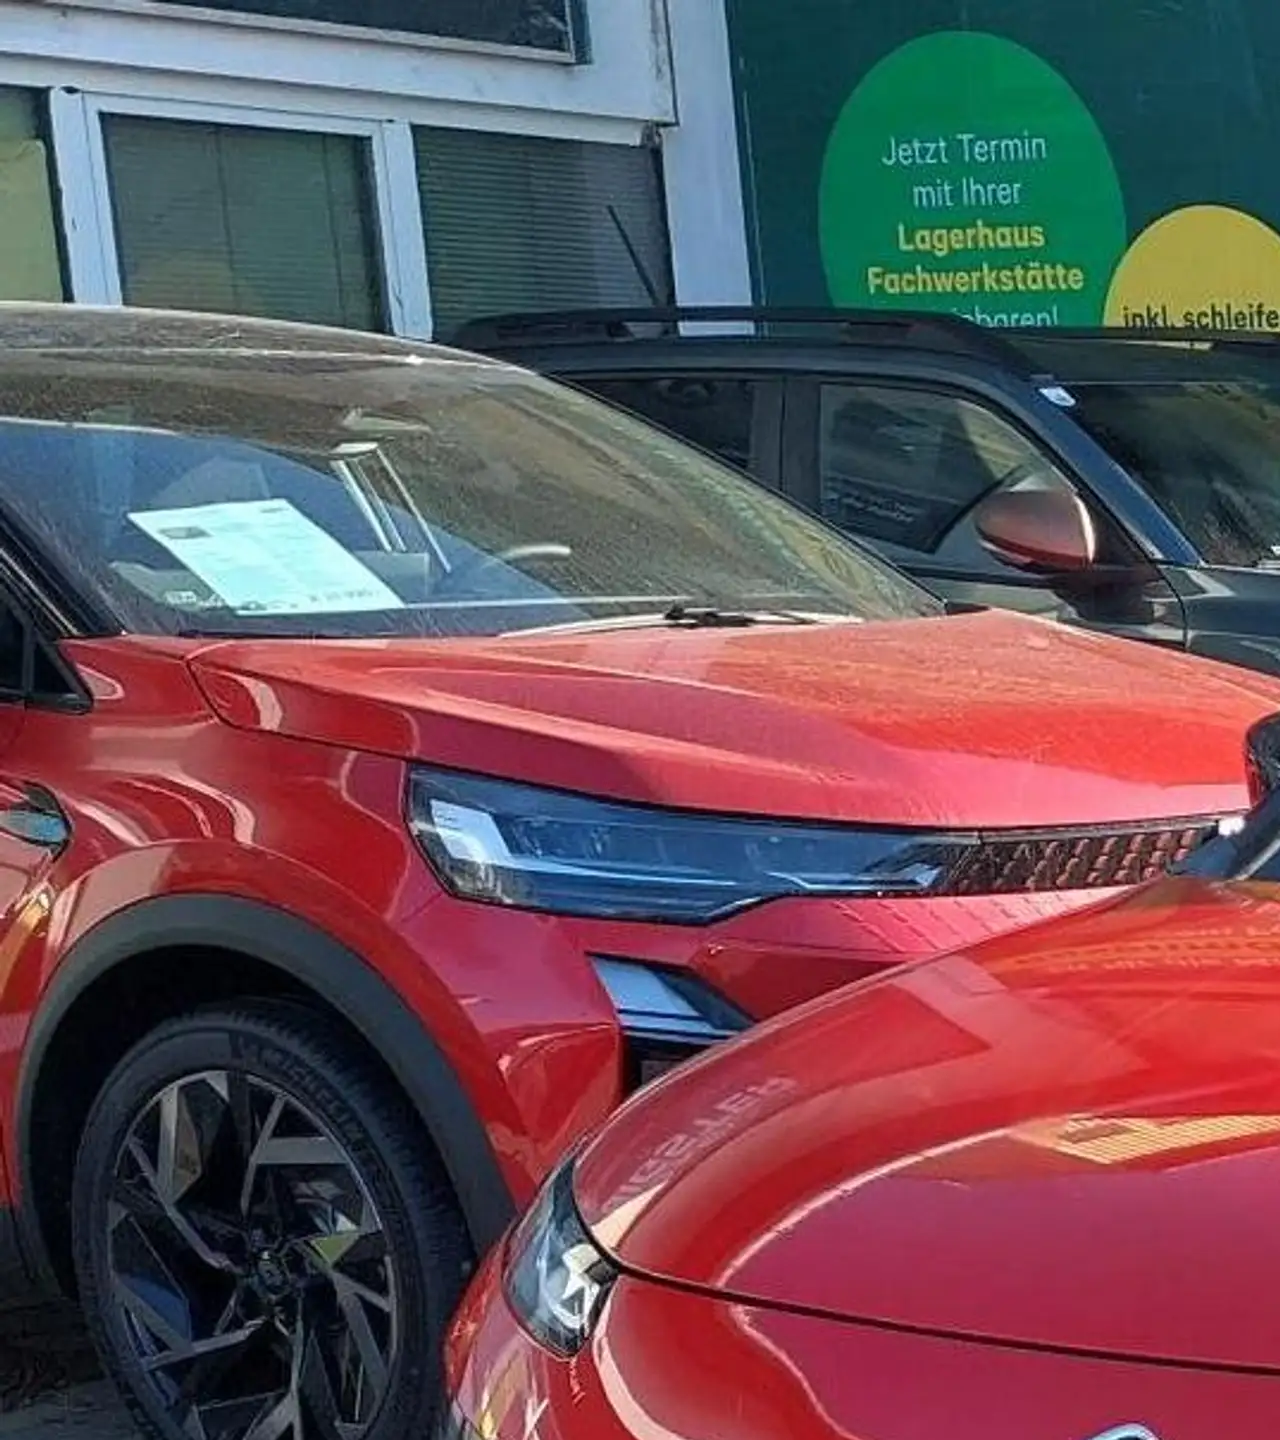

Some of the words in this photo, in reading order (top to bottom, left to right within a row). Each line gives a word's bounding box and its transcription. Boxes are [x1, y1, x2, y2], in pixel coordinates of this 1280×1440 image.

[882, 135, 949, 166] Jetzt
[957, 129, 1048, 163] Termin
[912, 179, 954, 207] mit
[962, 176, 1021, 206] Ihrer
[898, 218, 1046, 257] Lagerhaus
[867, 261, 1085, 295] Fachwerkstätte
[1122, 303, 1176, 330] inkl.
